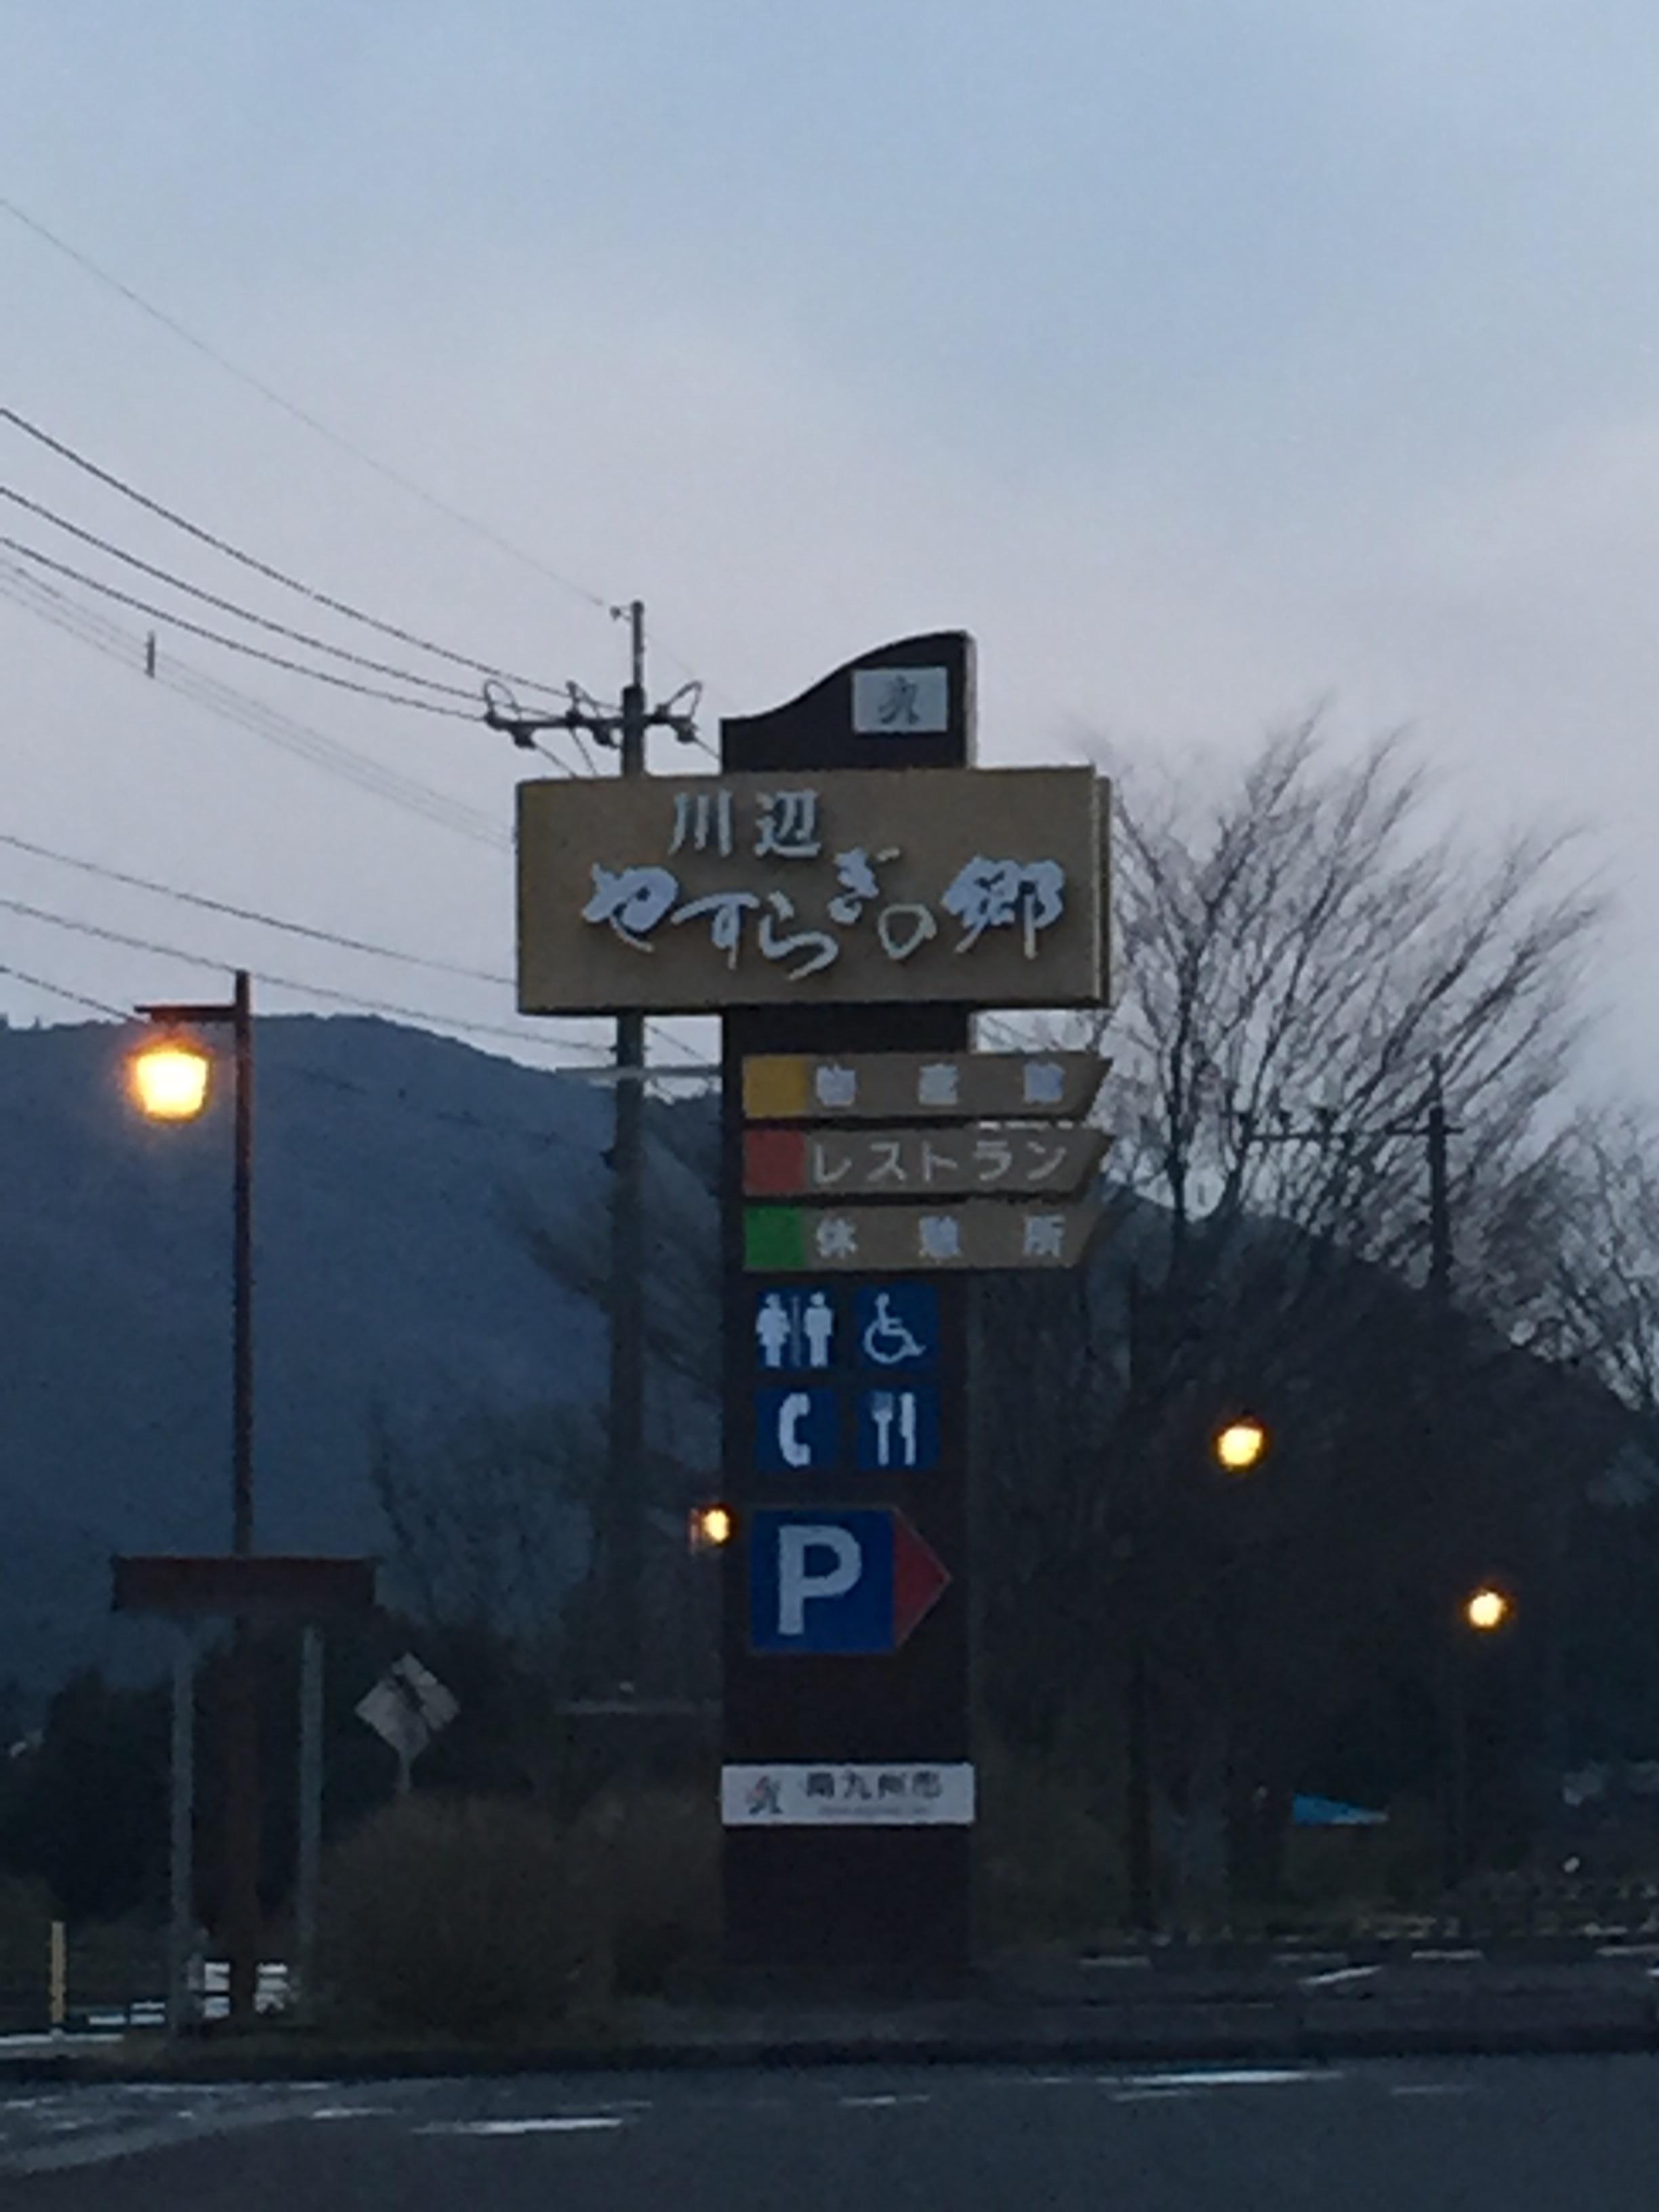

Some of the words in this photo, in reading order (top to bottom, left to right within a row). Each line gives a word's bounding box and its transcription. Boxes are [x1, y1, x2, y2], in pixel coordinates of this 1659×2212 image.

[668, 789, 820, 857] 川辺
[581, 847, 1065, 981] やすらぎの郷
[815, 1139, 1067, 1184] レストラン
[778, 1525, 862, 1635] P
